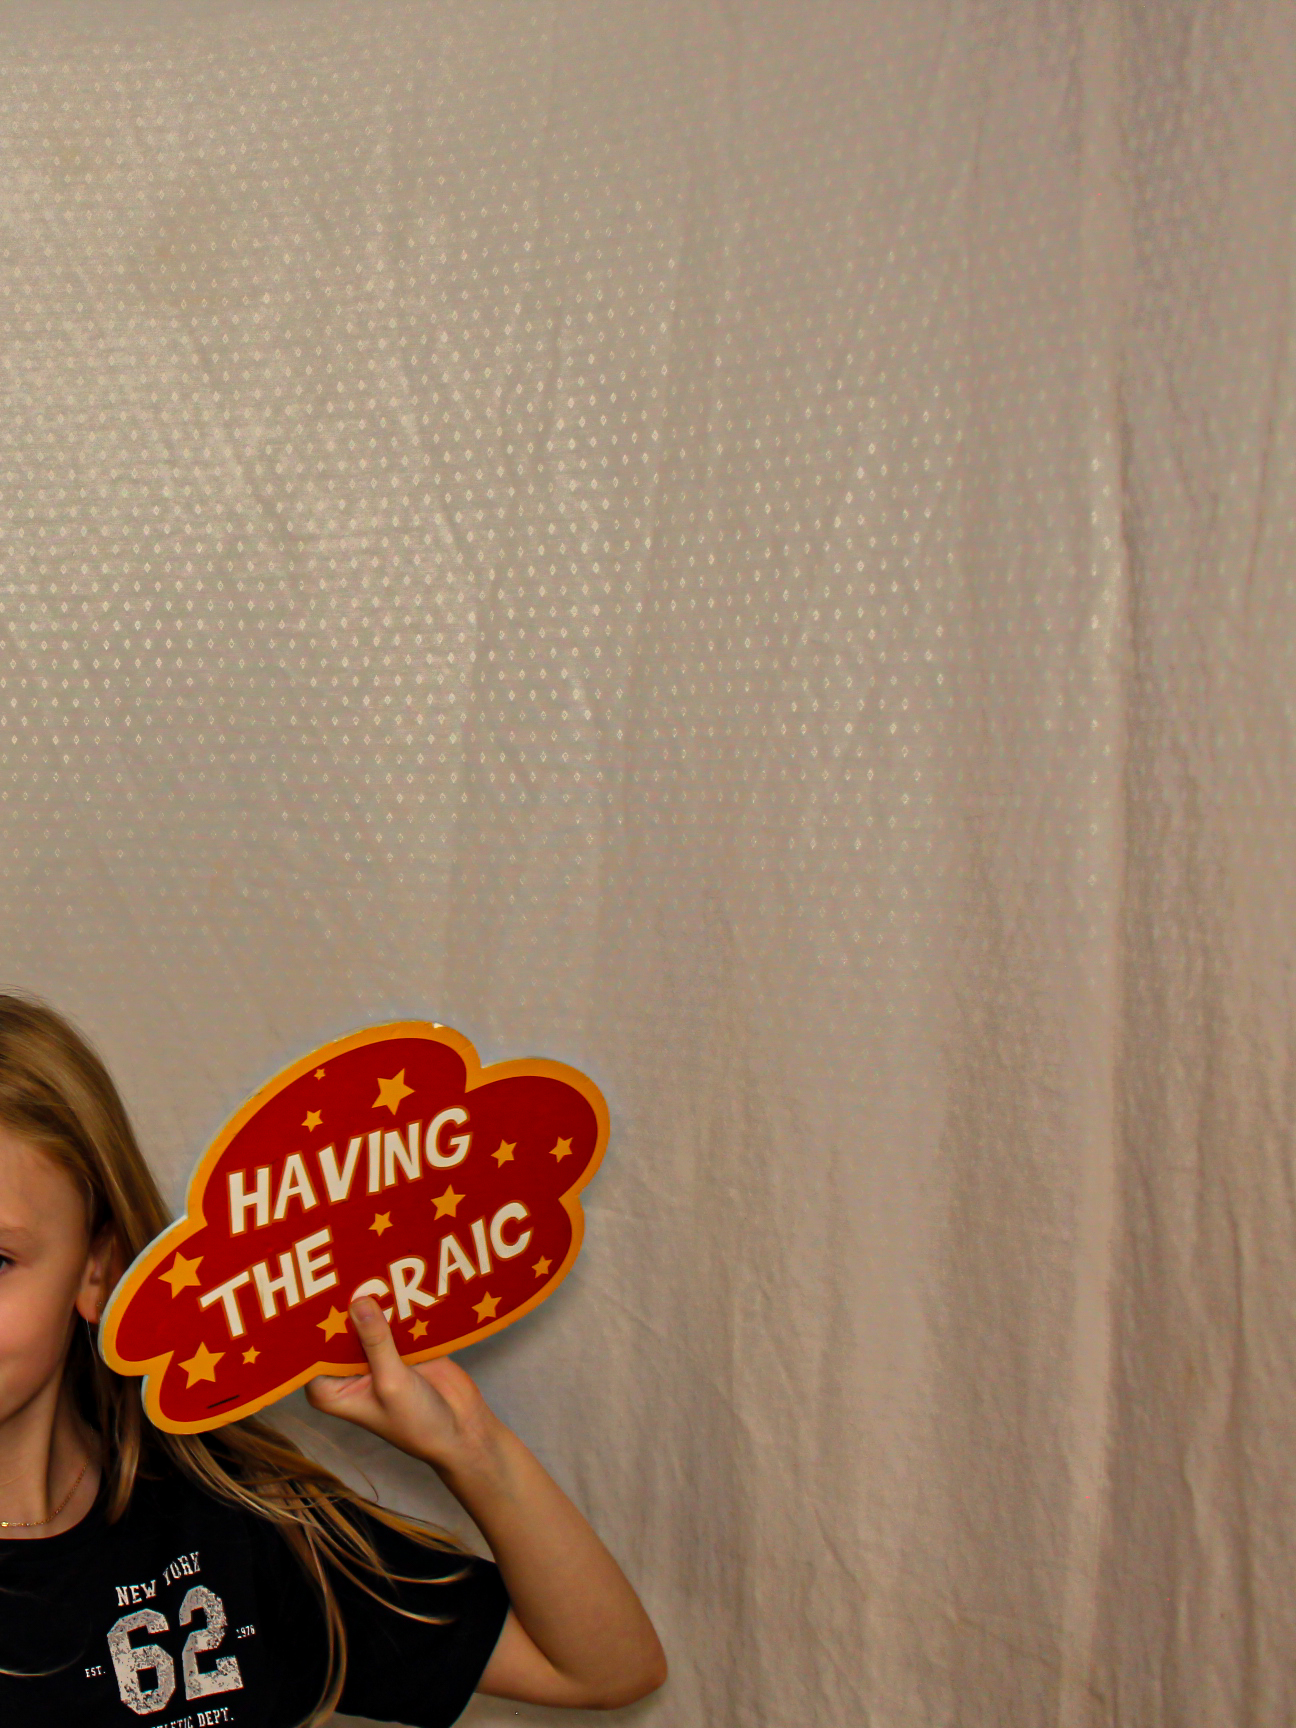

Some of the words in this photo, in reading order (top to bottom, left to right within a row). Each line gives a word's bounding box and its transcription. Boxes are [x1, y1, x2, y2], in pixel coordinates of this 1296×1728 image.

[227, 1106, 471, 1235] HAVING
[199, 1228, 337, 1338] THE
[350, 1201, 532, 1323] CRAIC
[115, 1579, 157, 1607] NEW
[162, 1551, 201, 1586] YORK
[85, 1665, 106, 1678] EST.
[107, 1584, 244, 1715] 62
[197, 1706, 234, 1727] DEPT.
